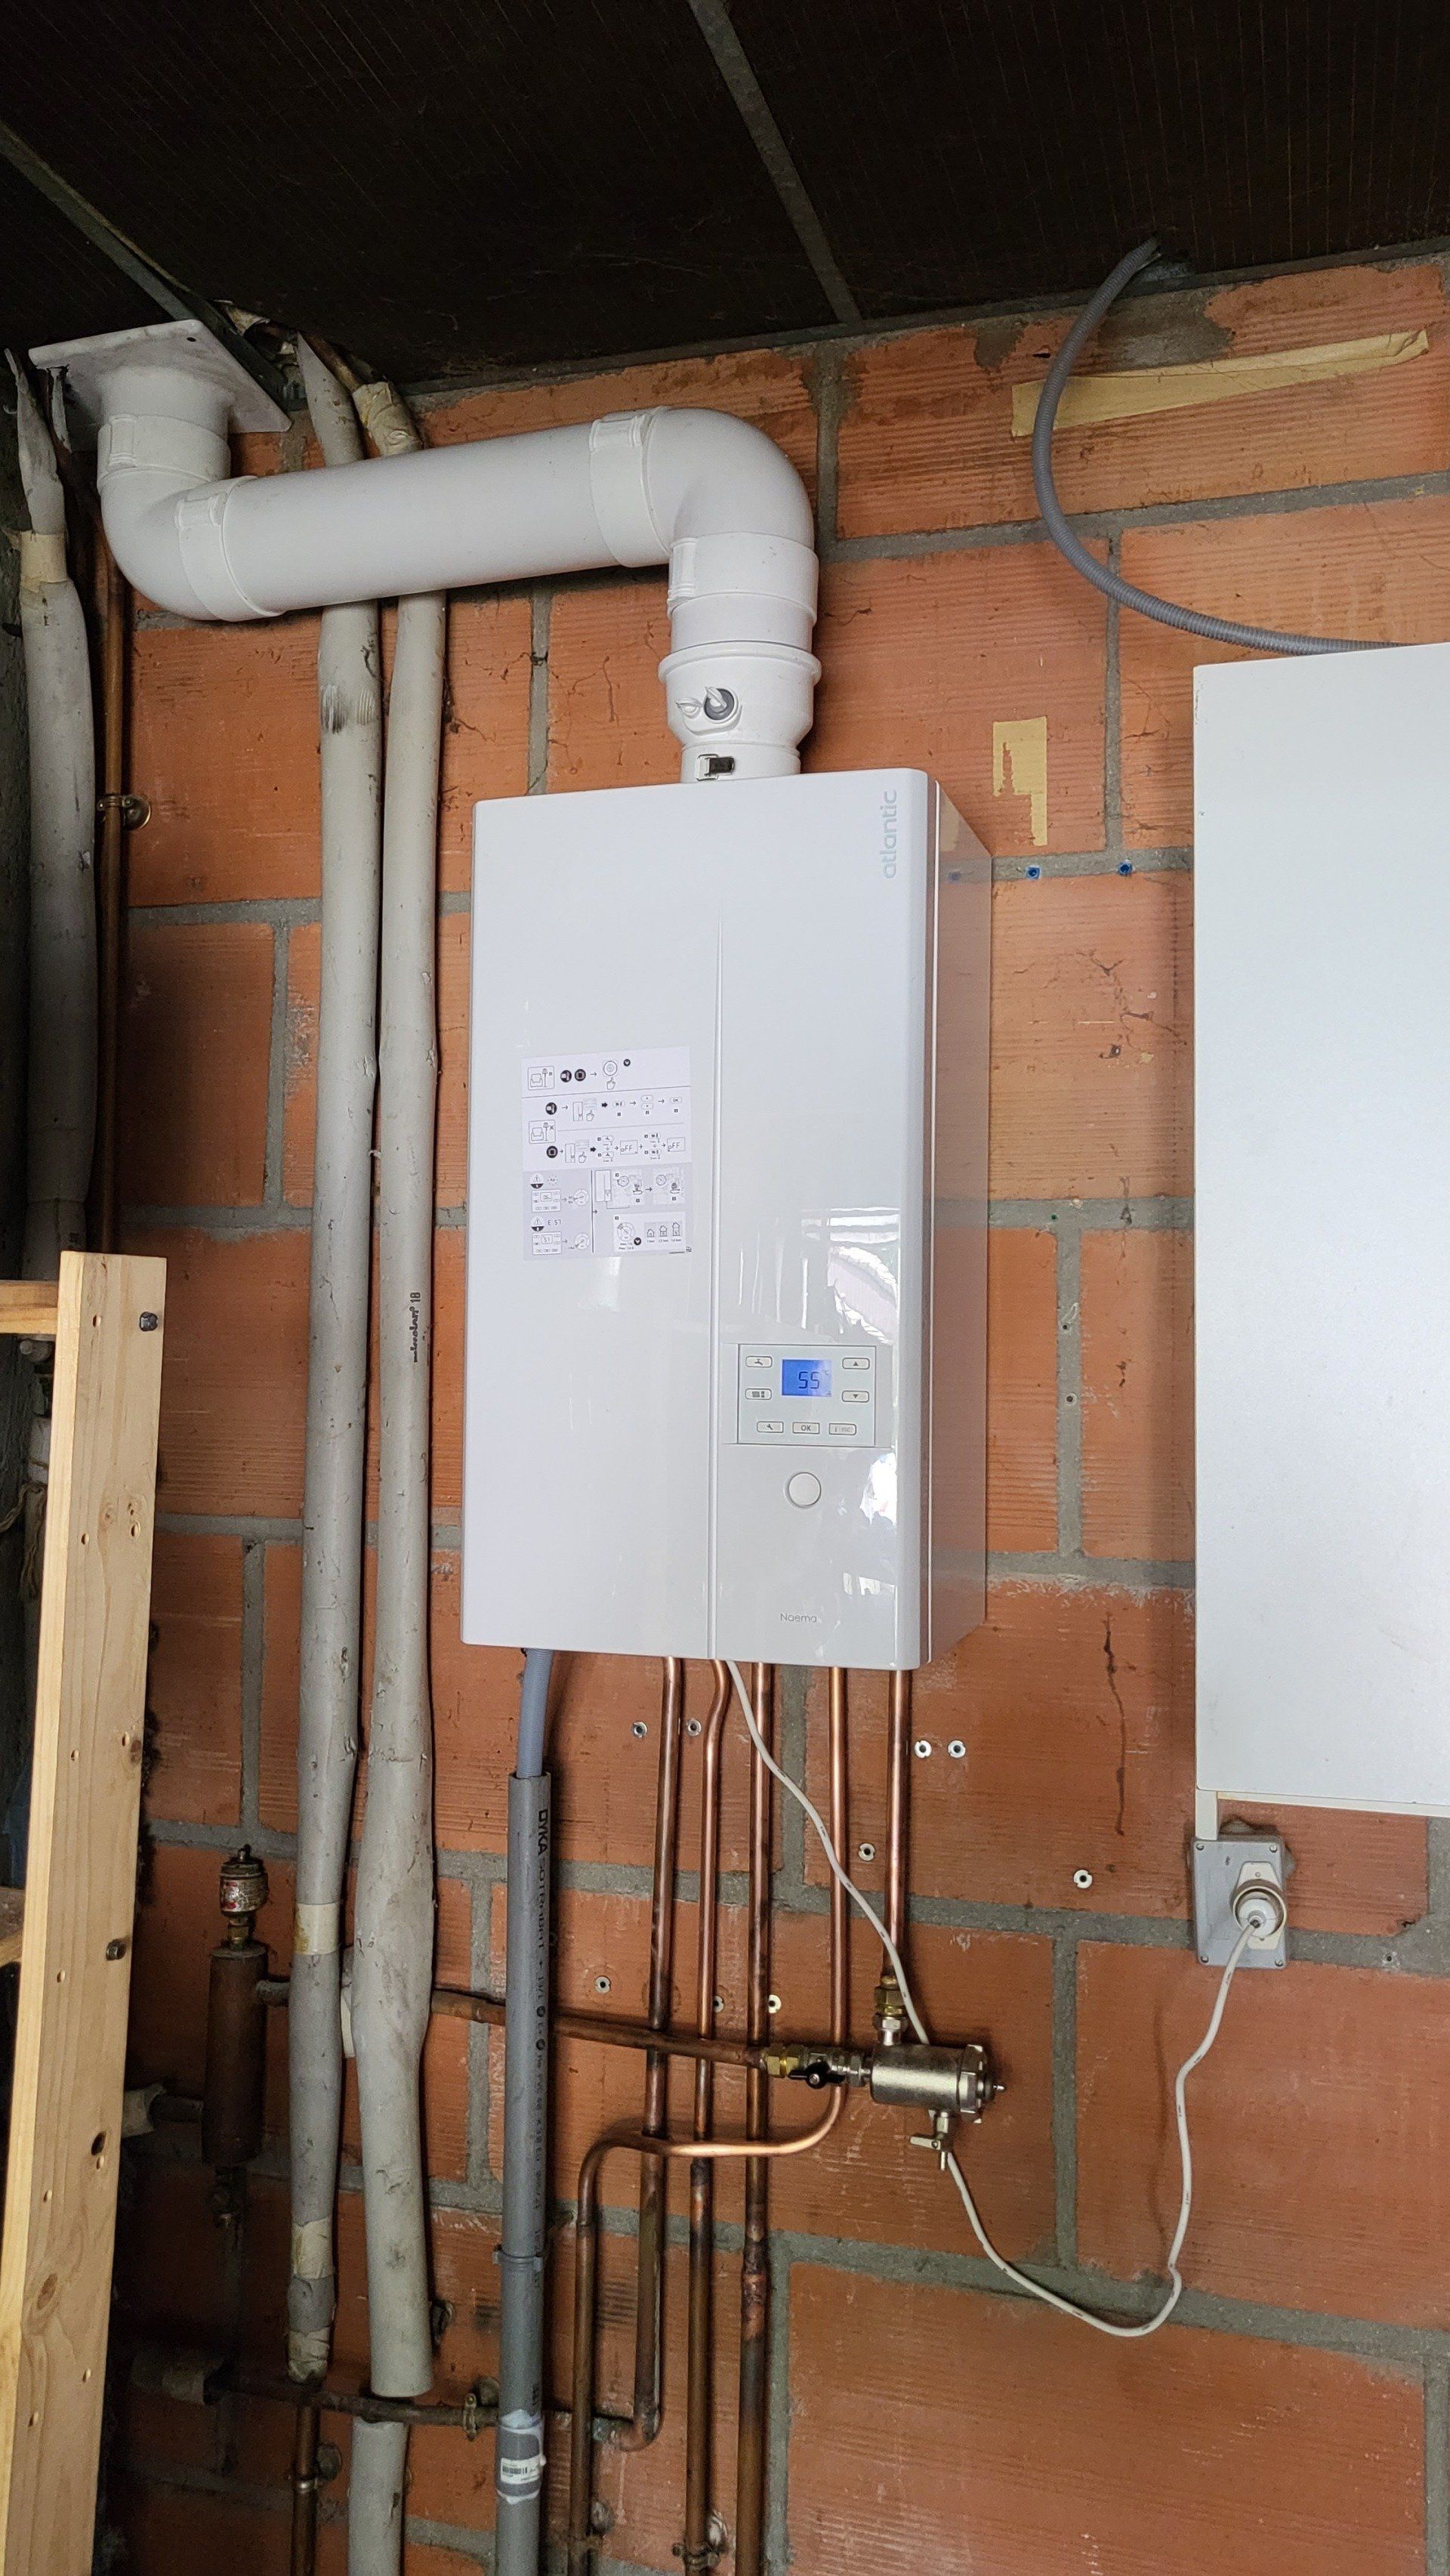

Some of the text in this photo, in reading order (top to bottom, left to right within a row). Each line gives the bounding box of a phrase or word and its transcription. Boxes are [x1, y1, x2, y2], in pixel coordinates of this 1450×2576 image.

[880, 789, 896, 879] atlantic
[409, 1292, 421, 1303] 18
[798, 1371, 820, 1389] 55
[801, 1423, 811, 1432] OK
[780, 1612, 817, 1623] Naema
[538, 1808, 548, 1855] DYKA
